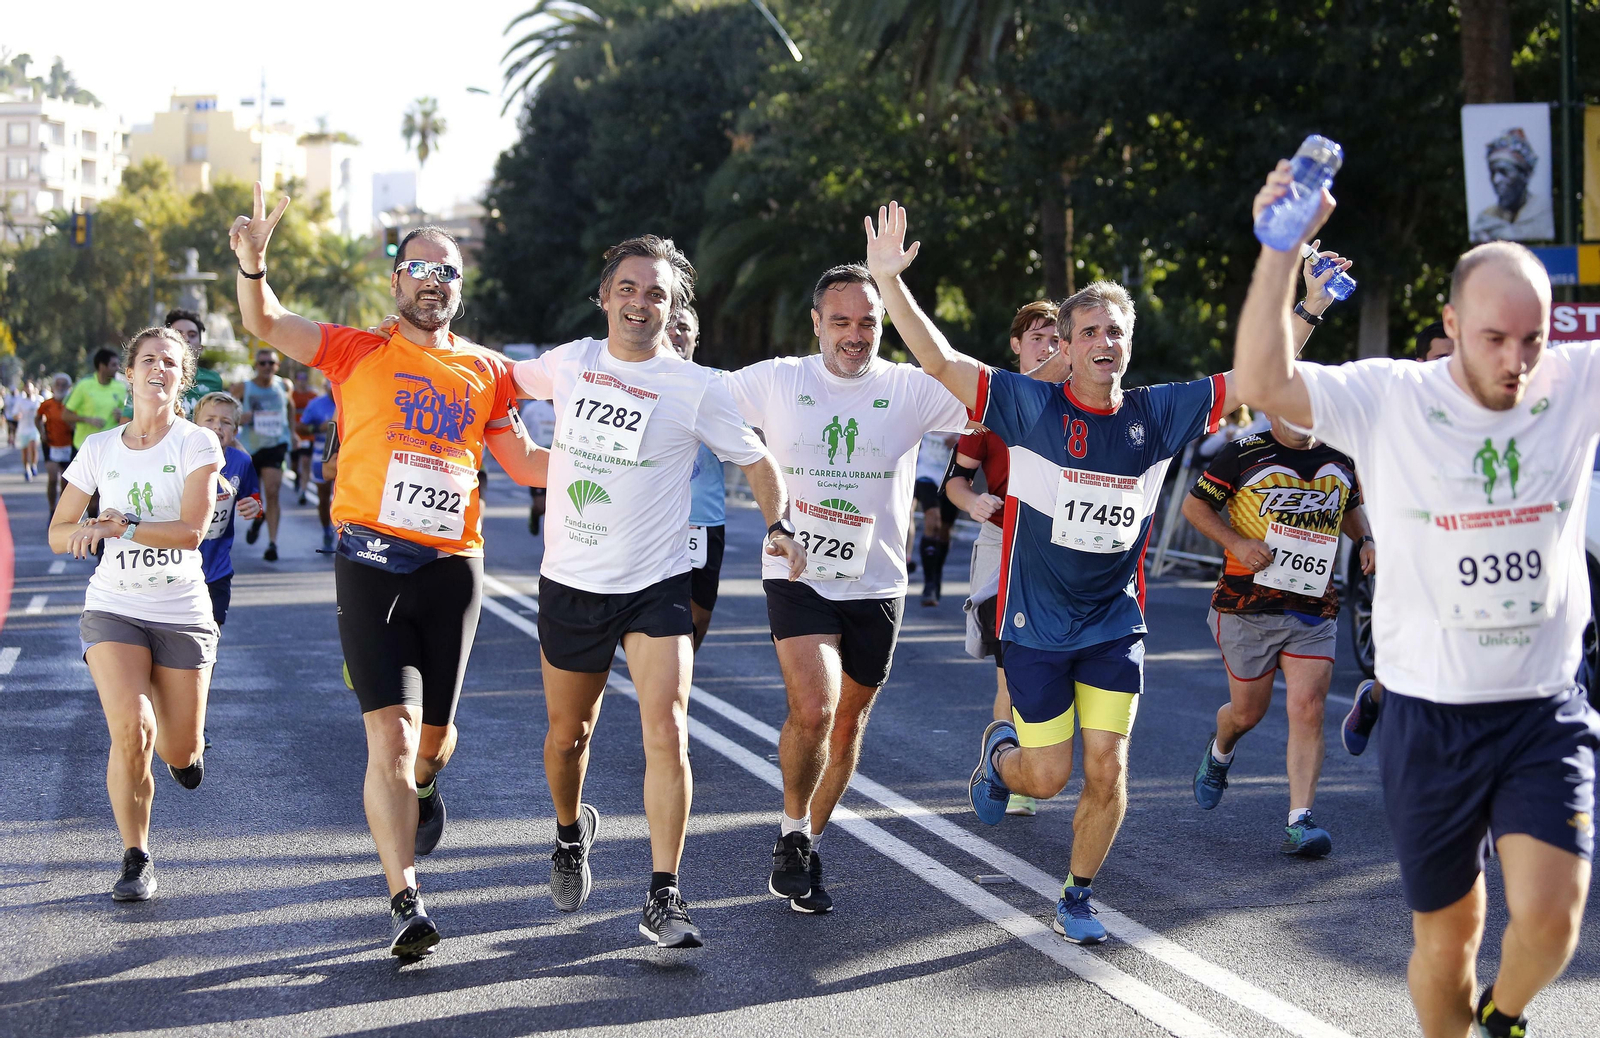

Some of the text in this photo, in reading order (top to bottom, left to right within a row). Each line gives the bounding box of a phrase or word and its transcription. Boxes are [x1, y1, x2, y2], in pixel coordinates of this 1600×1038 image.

[583, 371, 660, 400] 41 CARRERA URBANA
[575, 398, 642, 432] 17282
[394, 453, 409, 465] 41
[410, 454, 443, 468] CARRERA
[568, 446, 602, 462] CARRERA
[604, 455, 638, 467] URBANA
[795, 467, 882, 479] 41 CARRERA URBANA
[1063, 470, 1079, 484] 41
[1080, 472, 1116, 484] CARRERA
[1080, 479, 1102, 487] CIUDAD
[817, 480, 823, 488] El
[394, 481, 461, 514] 17322
[1251, 484, 1340, 517] TEBA
[796, 499, 874, 525] 41 CARRERA URBANA
[808, 511, 829, 521] CIUDAD
[1064, 499, 1135, 528] 17459
[1276, 510, 1340, 530] RUNNING
[564, 515, 608, 532] Fundación
[1271, 523, 1337, 543] 41 CARRERA URBANA
[1435, 515, 1458, 531] 41
[568, 531, 598, 547] Unicaja
[799, 530, 856, 561] 3726
[115, 549, 183, 570] 17650
[356, 550, 388, 564] adidas
[1270, 547, 1328, 576] 17665
[1458, 549, 1542, 587] 9389
[1478, 630, 1532, 647] Unicaja
